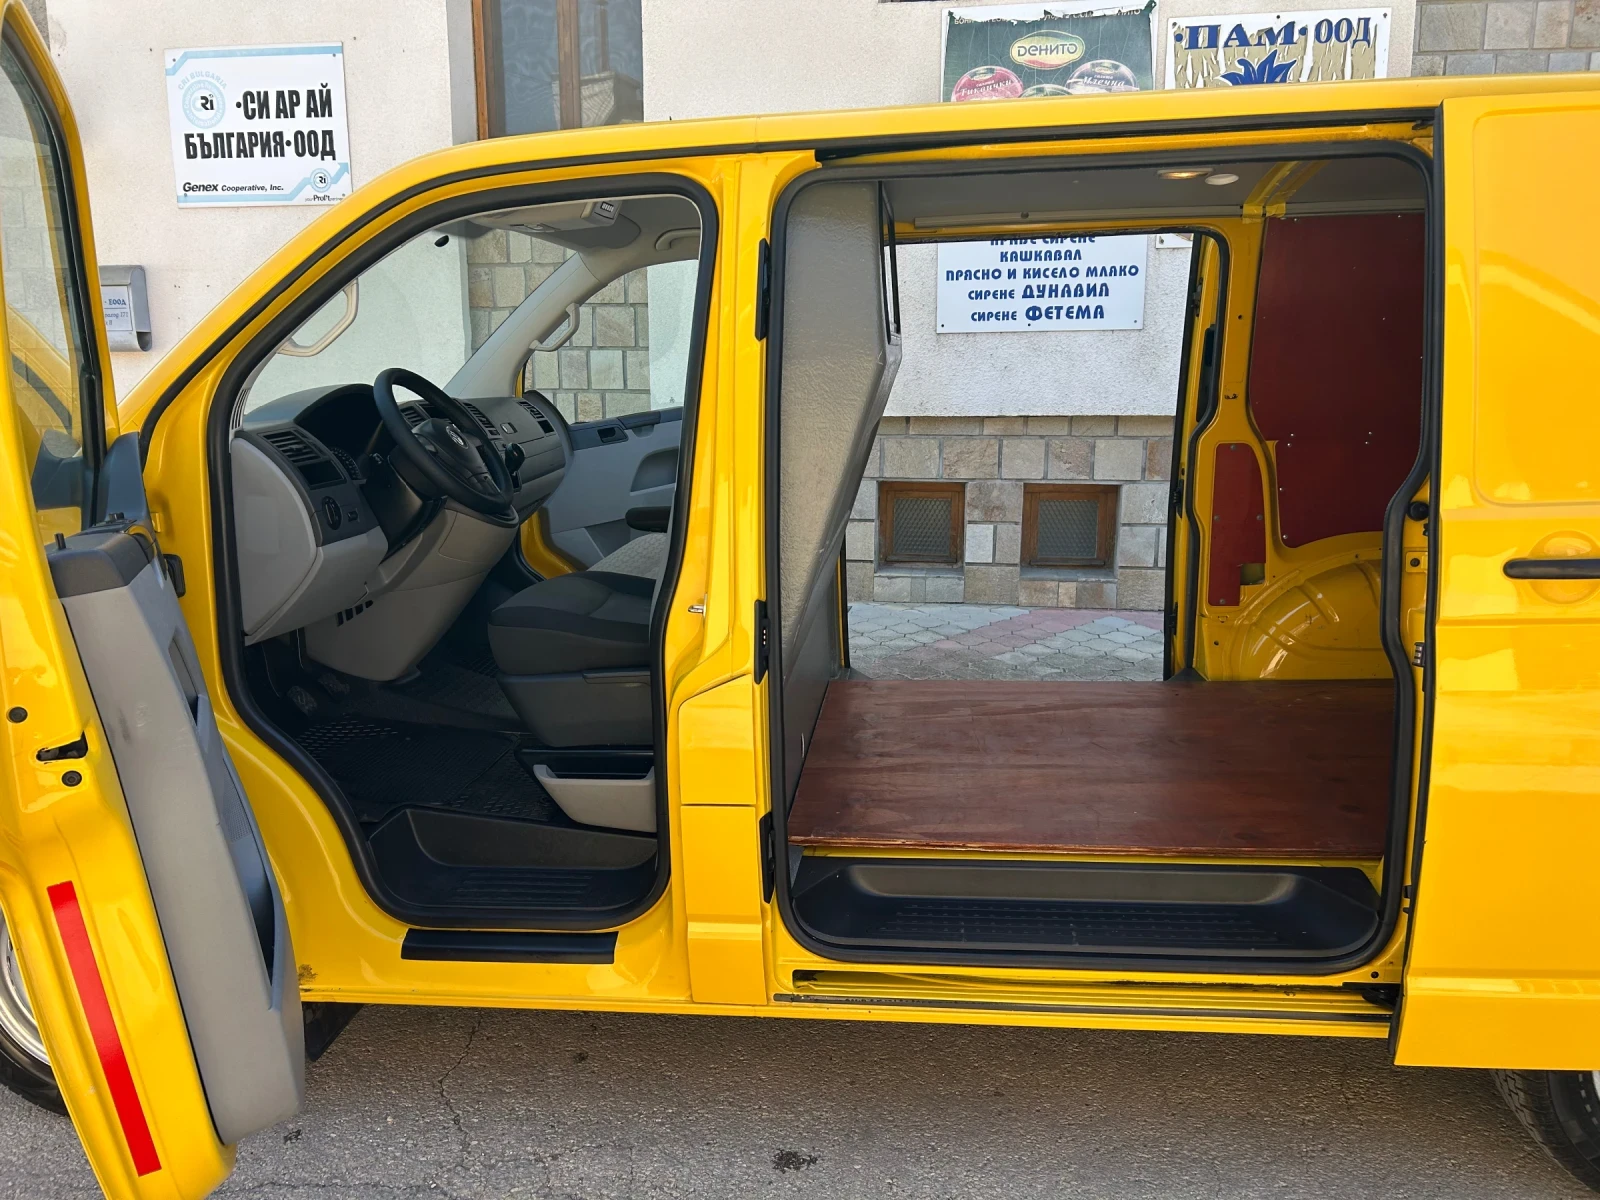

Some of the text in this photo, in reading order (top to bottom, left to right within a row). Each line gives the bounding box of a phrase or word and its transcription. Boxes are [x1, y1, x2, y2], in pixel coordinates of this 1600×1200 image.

[1315, 17, 1371, 49] ООД
[275, 90, 301, 119] АР
[306, 82, 333, 118] АЙ
[182, 181, 284, 193] Genex Cooperative, Inc.
[1000, 249, 1082, 262] КАШКАВАЛ
[945, 265, 1140, 281] ПРЯСНО И КИСЕЛО МЛЯКО
[968, 282, 1110, 300] СИРЕНЕ ДУНАВИЛ
[970, 304, 1105, 322] СИРЕНЕ ФЕТЕМА
